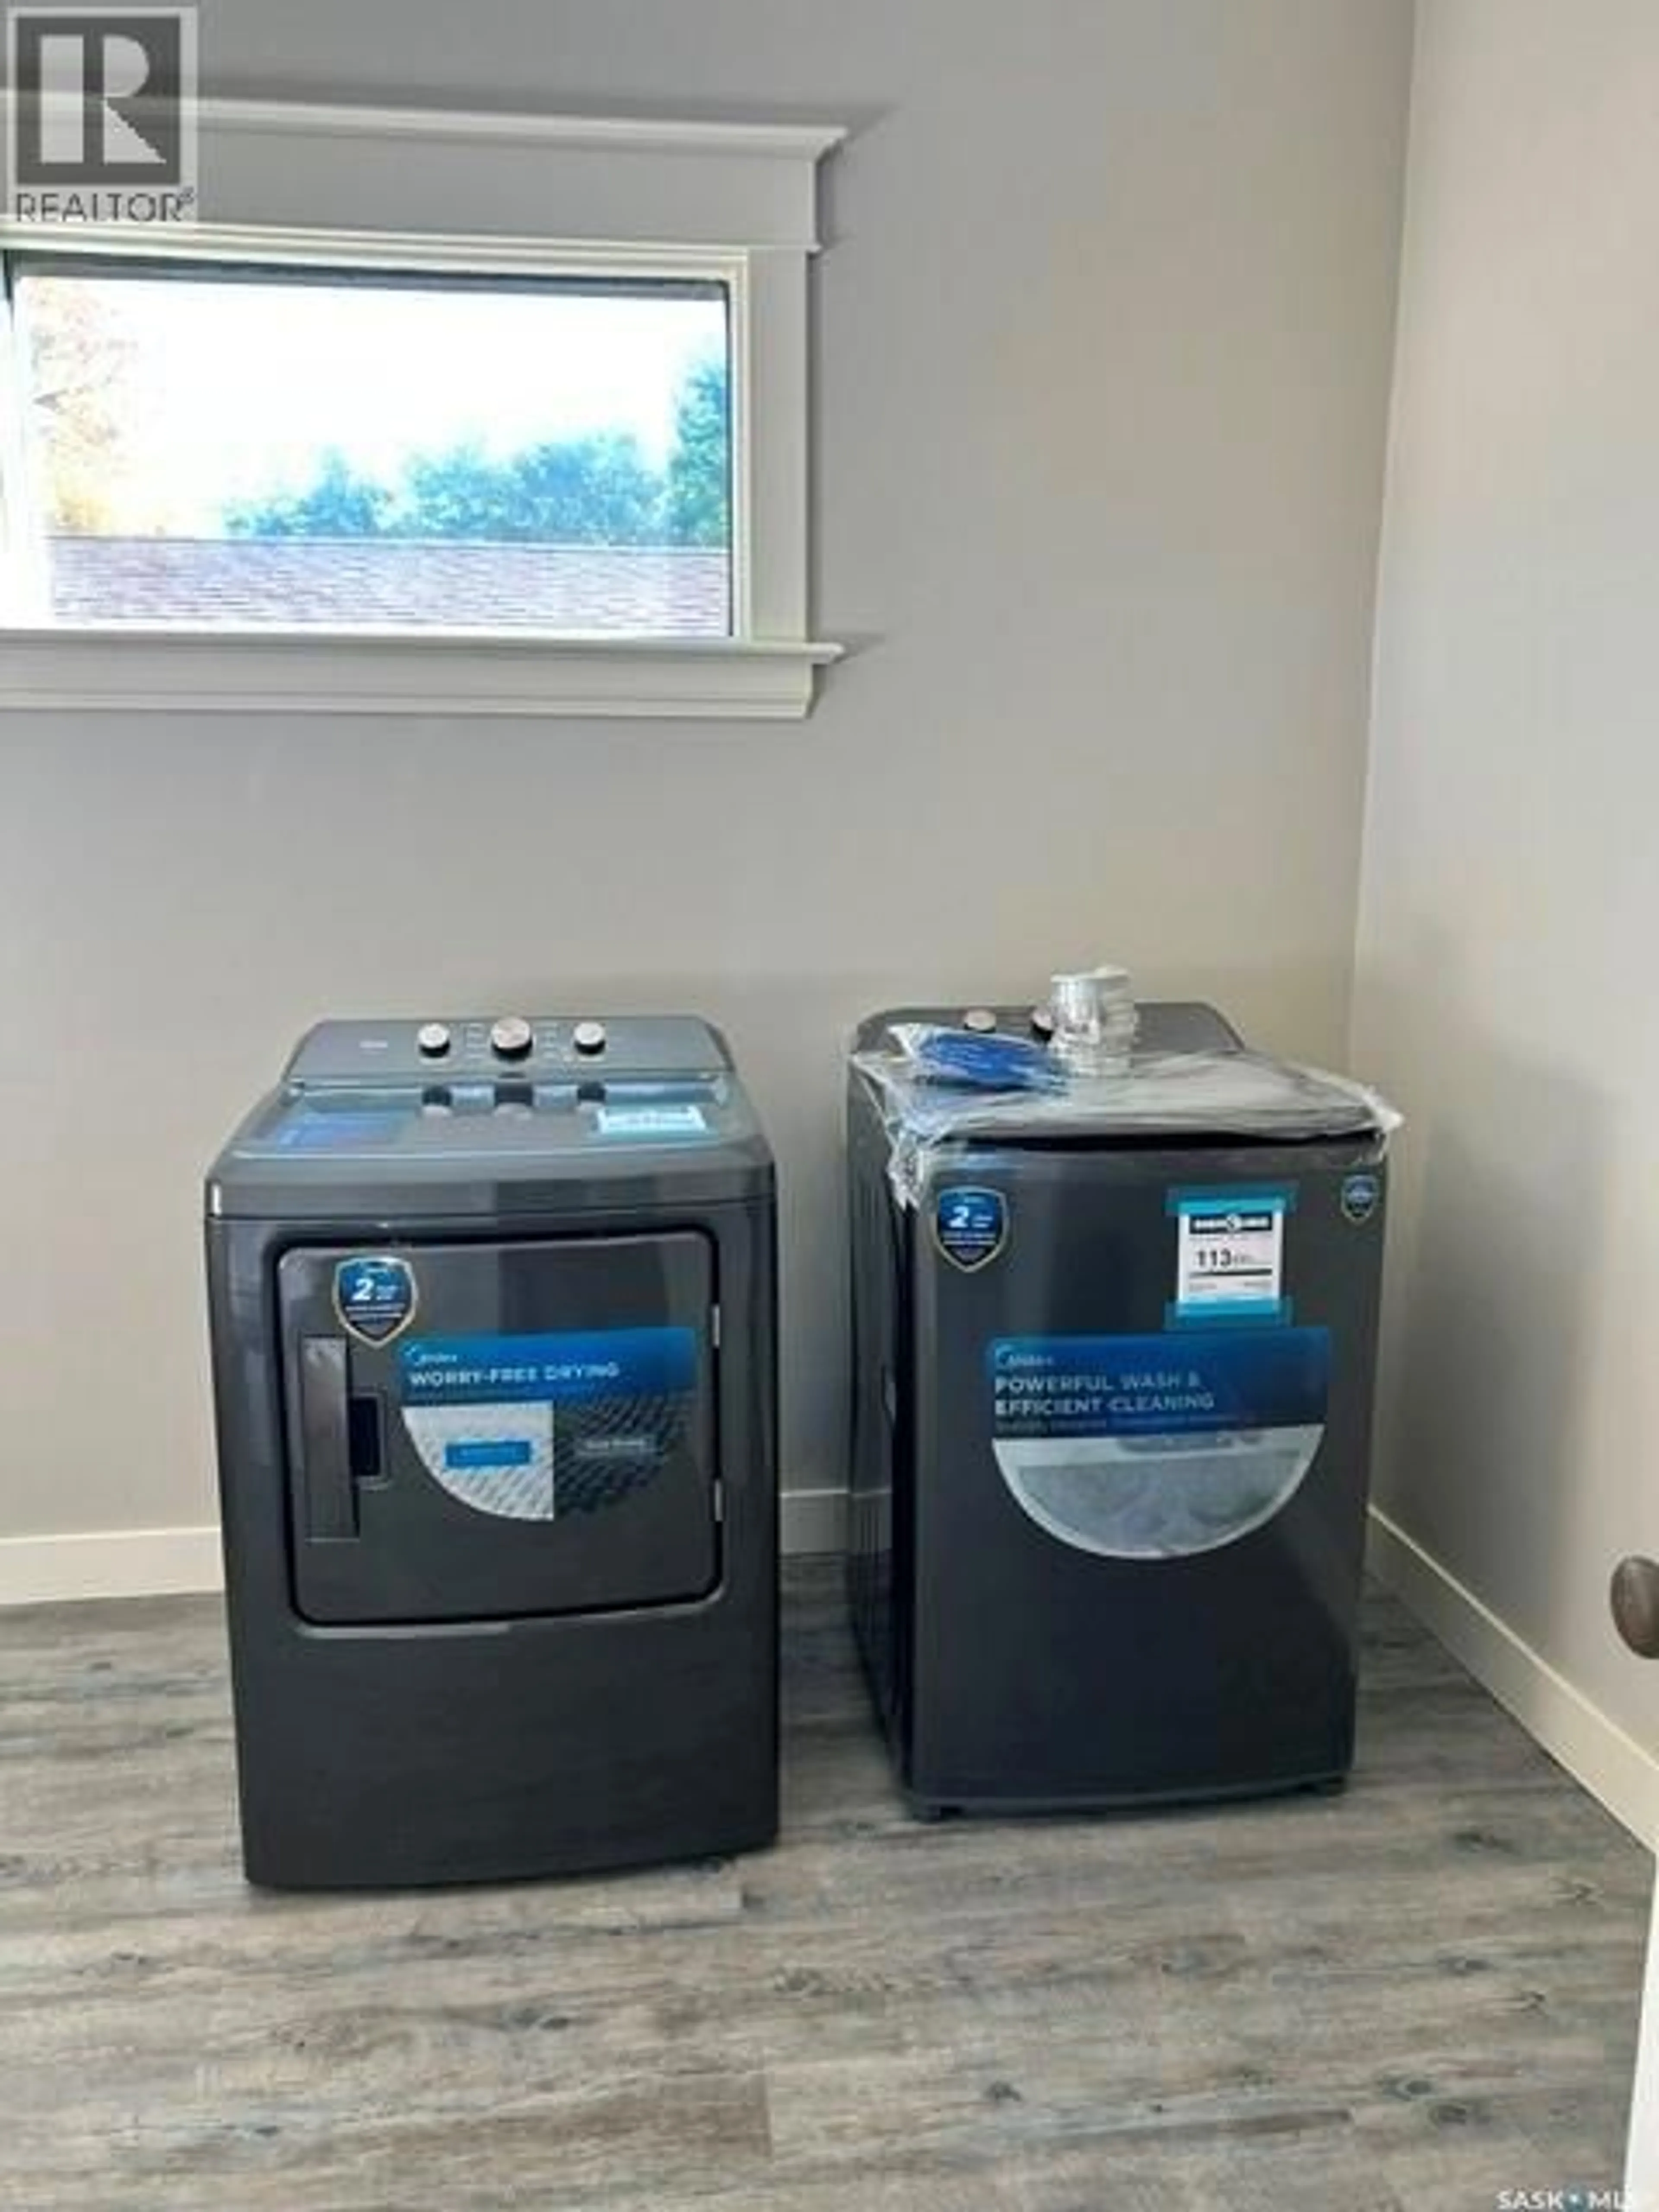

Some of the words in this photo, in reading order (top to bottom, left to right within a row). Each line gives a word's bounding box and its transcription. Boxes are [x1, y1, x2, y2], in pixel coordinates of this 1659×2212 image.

[948, 1205, 970, 1228] 2
[1196, 1248, 1232, 1267] 113
[351, 1278, 375, 1301] 2
[995, 1374, 1115, 1394] POWERFUL
[1120, 1370, 1180, 1391] WASH
[995, 1397, 1104, 1417] EFFICIENT
[1107, 1391, 1215, 1414] CLEANING
